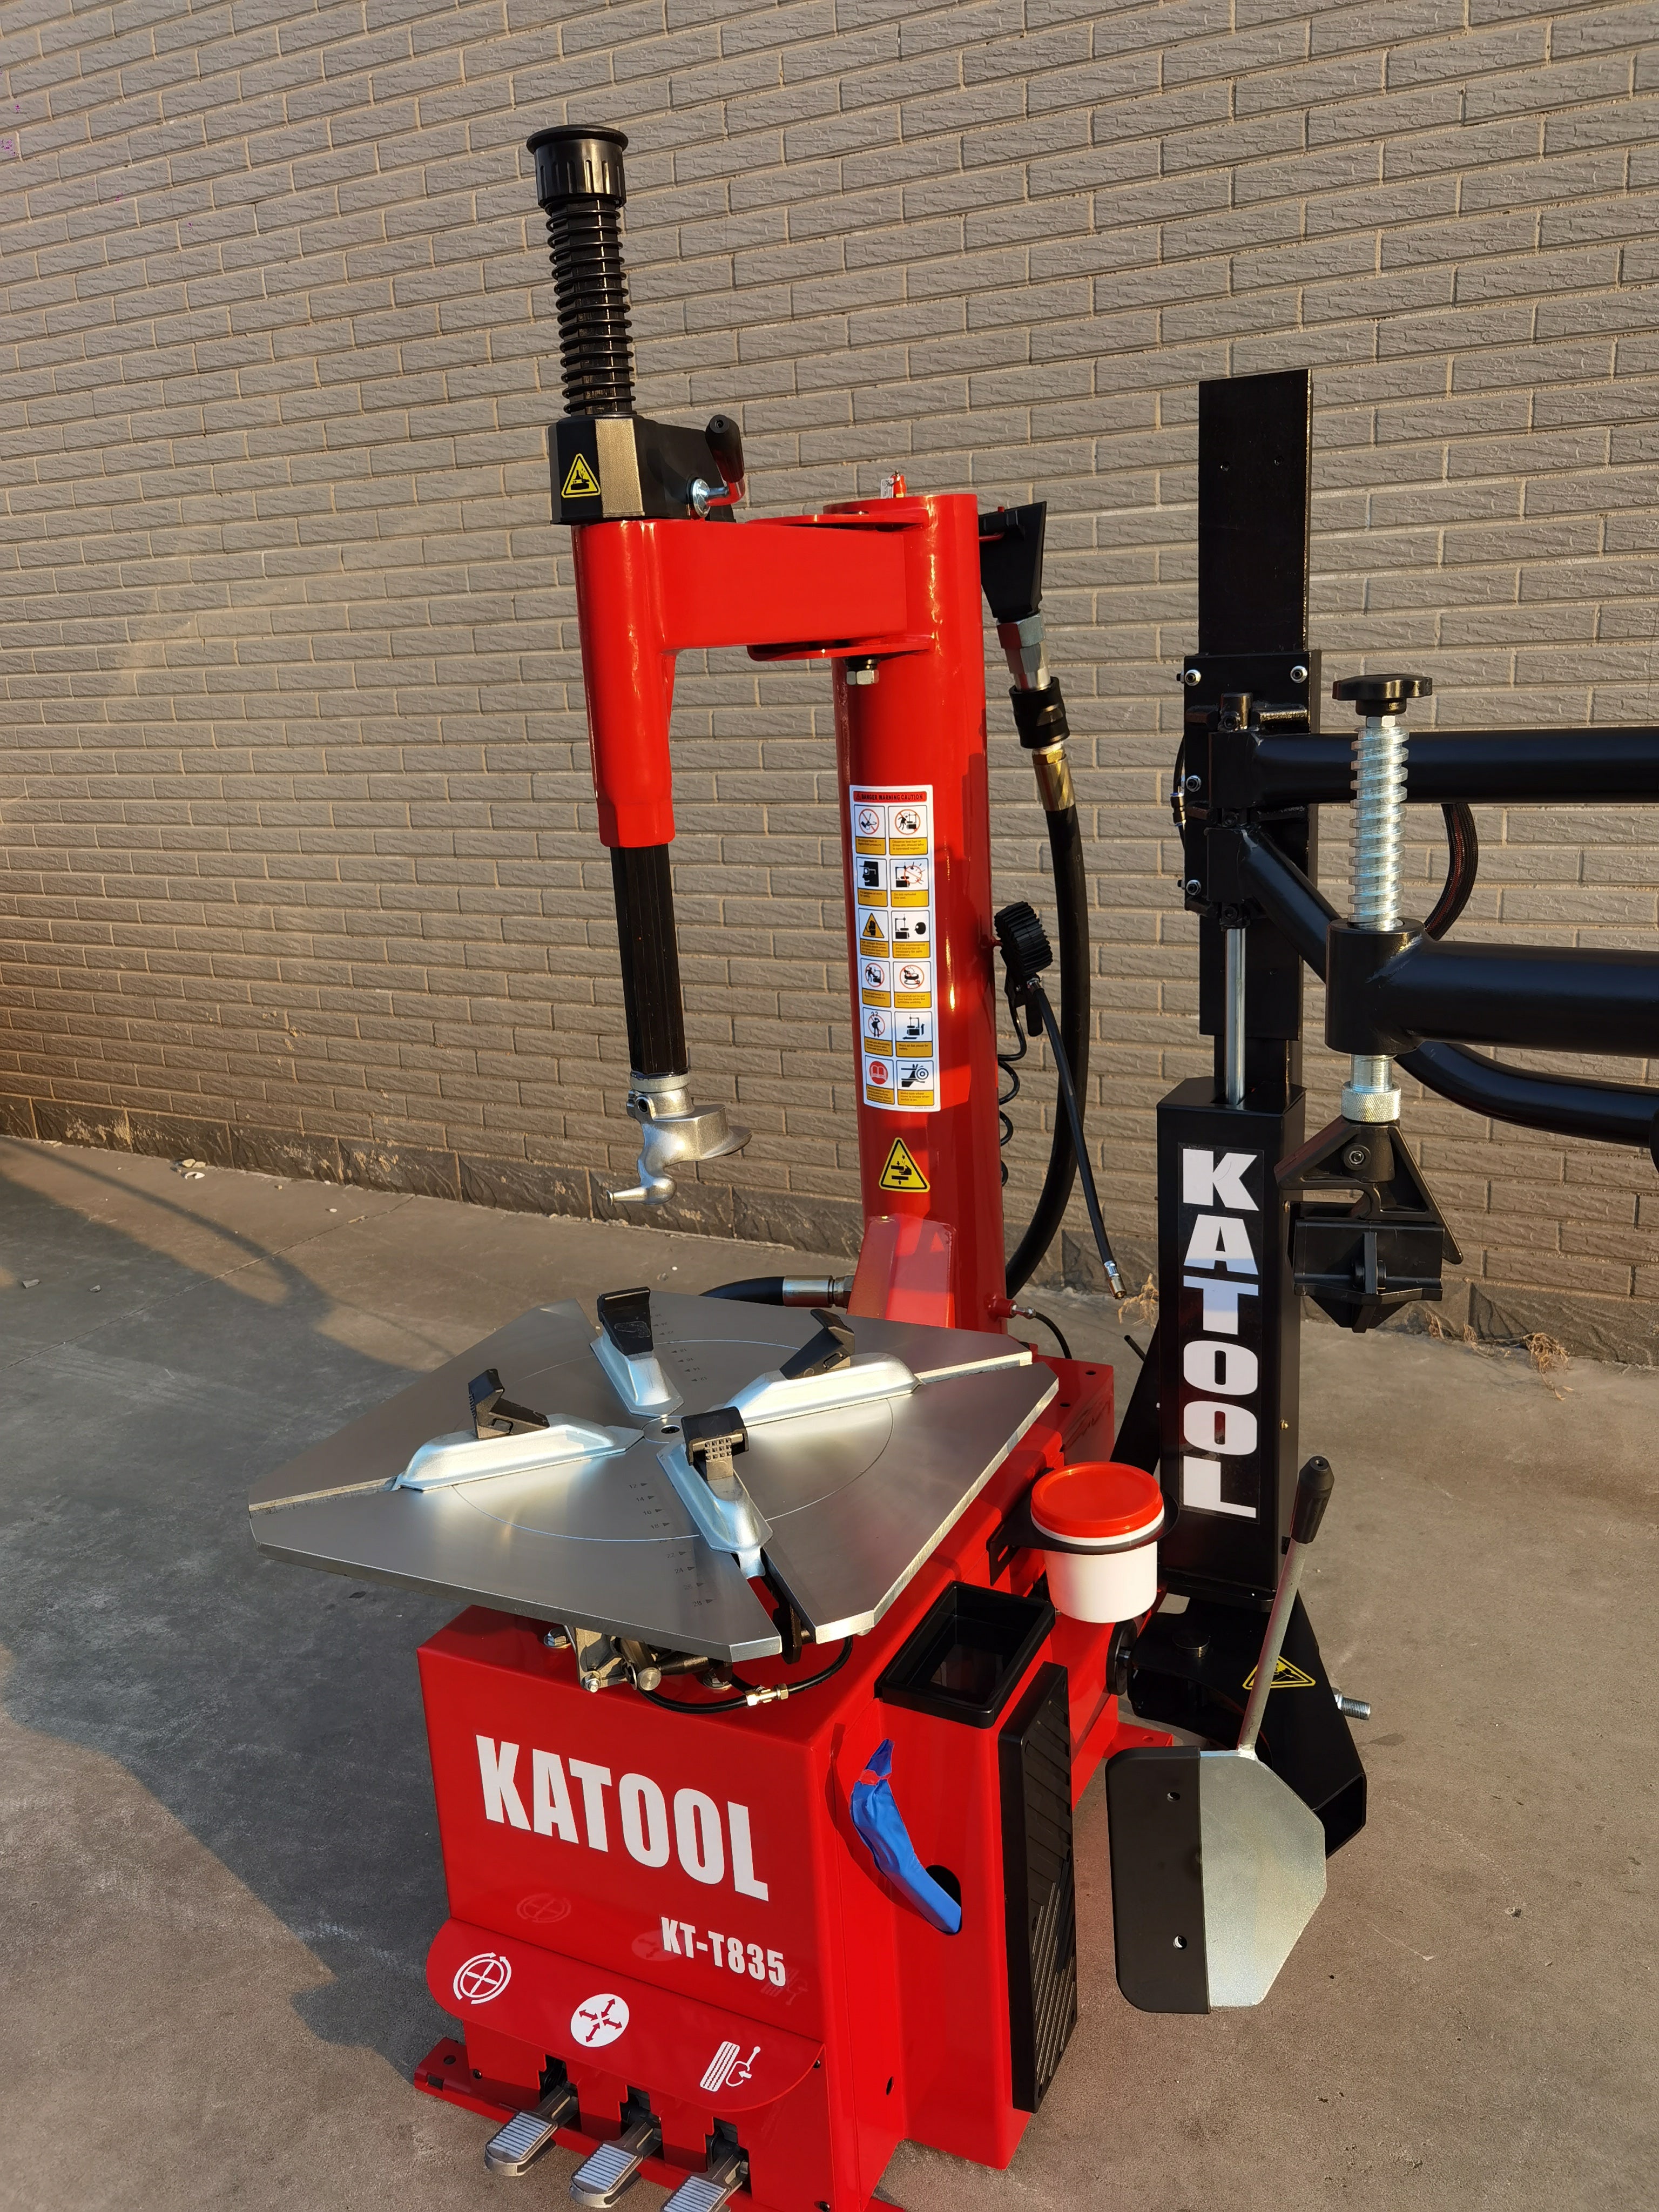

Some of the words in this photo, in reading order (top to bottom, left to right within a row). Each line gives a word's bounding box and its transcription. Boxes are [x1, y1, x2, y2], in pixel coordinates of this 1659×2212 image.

[1183, 1148, 1259, 1519] KATOOL
[476, 1734, 769, 1902] KATOOL
[661, 1917, 786, 1987] KT-T835
